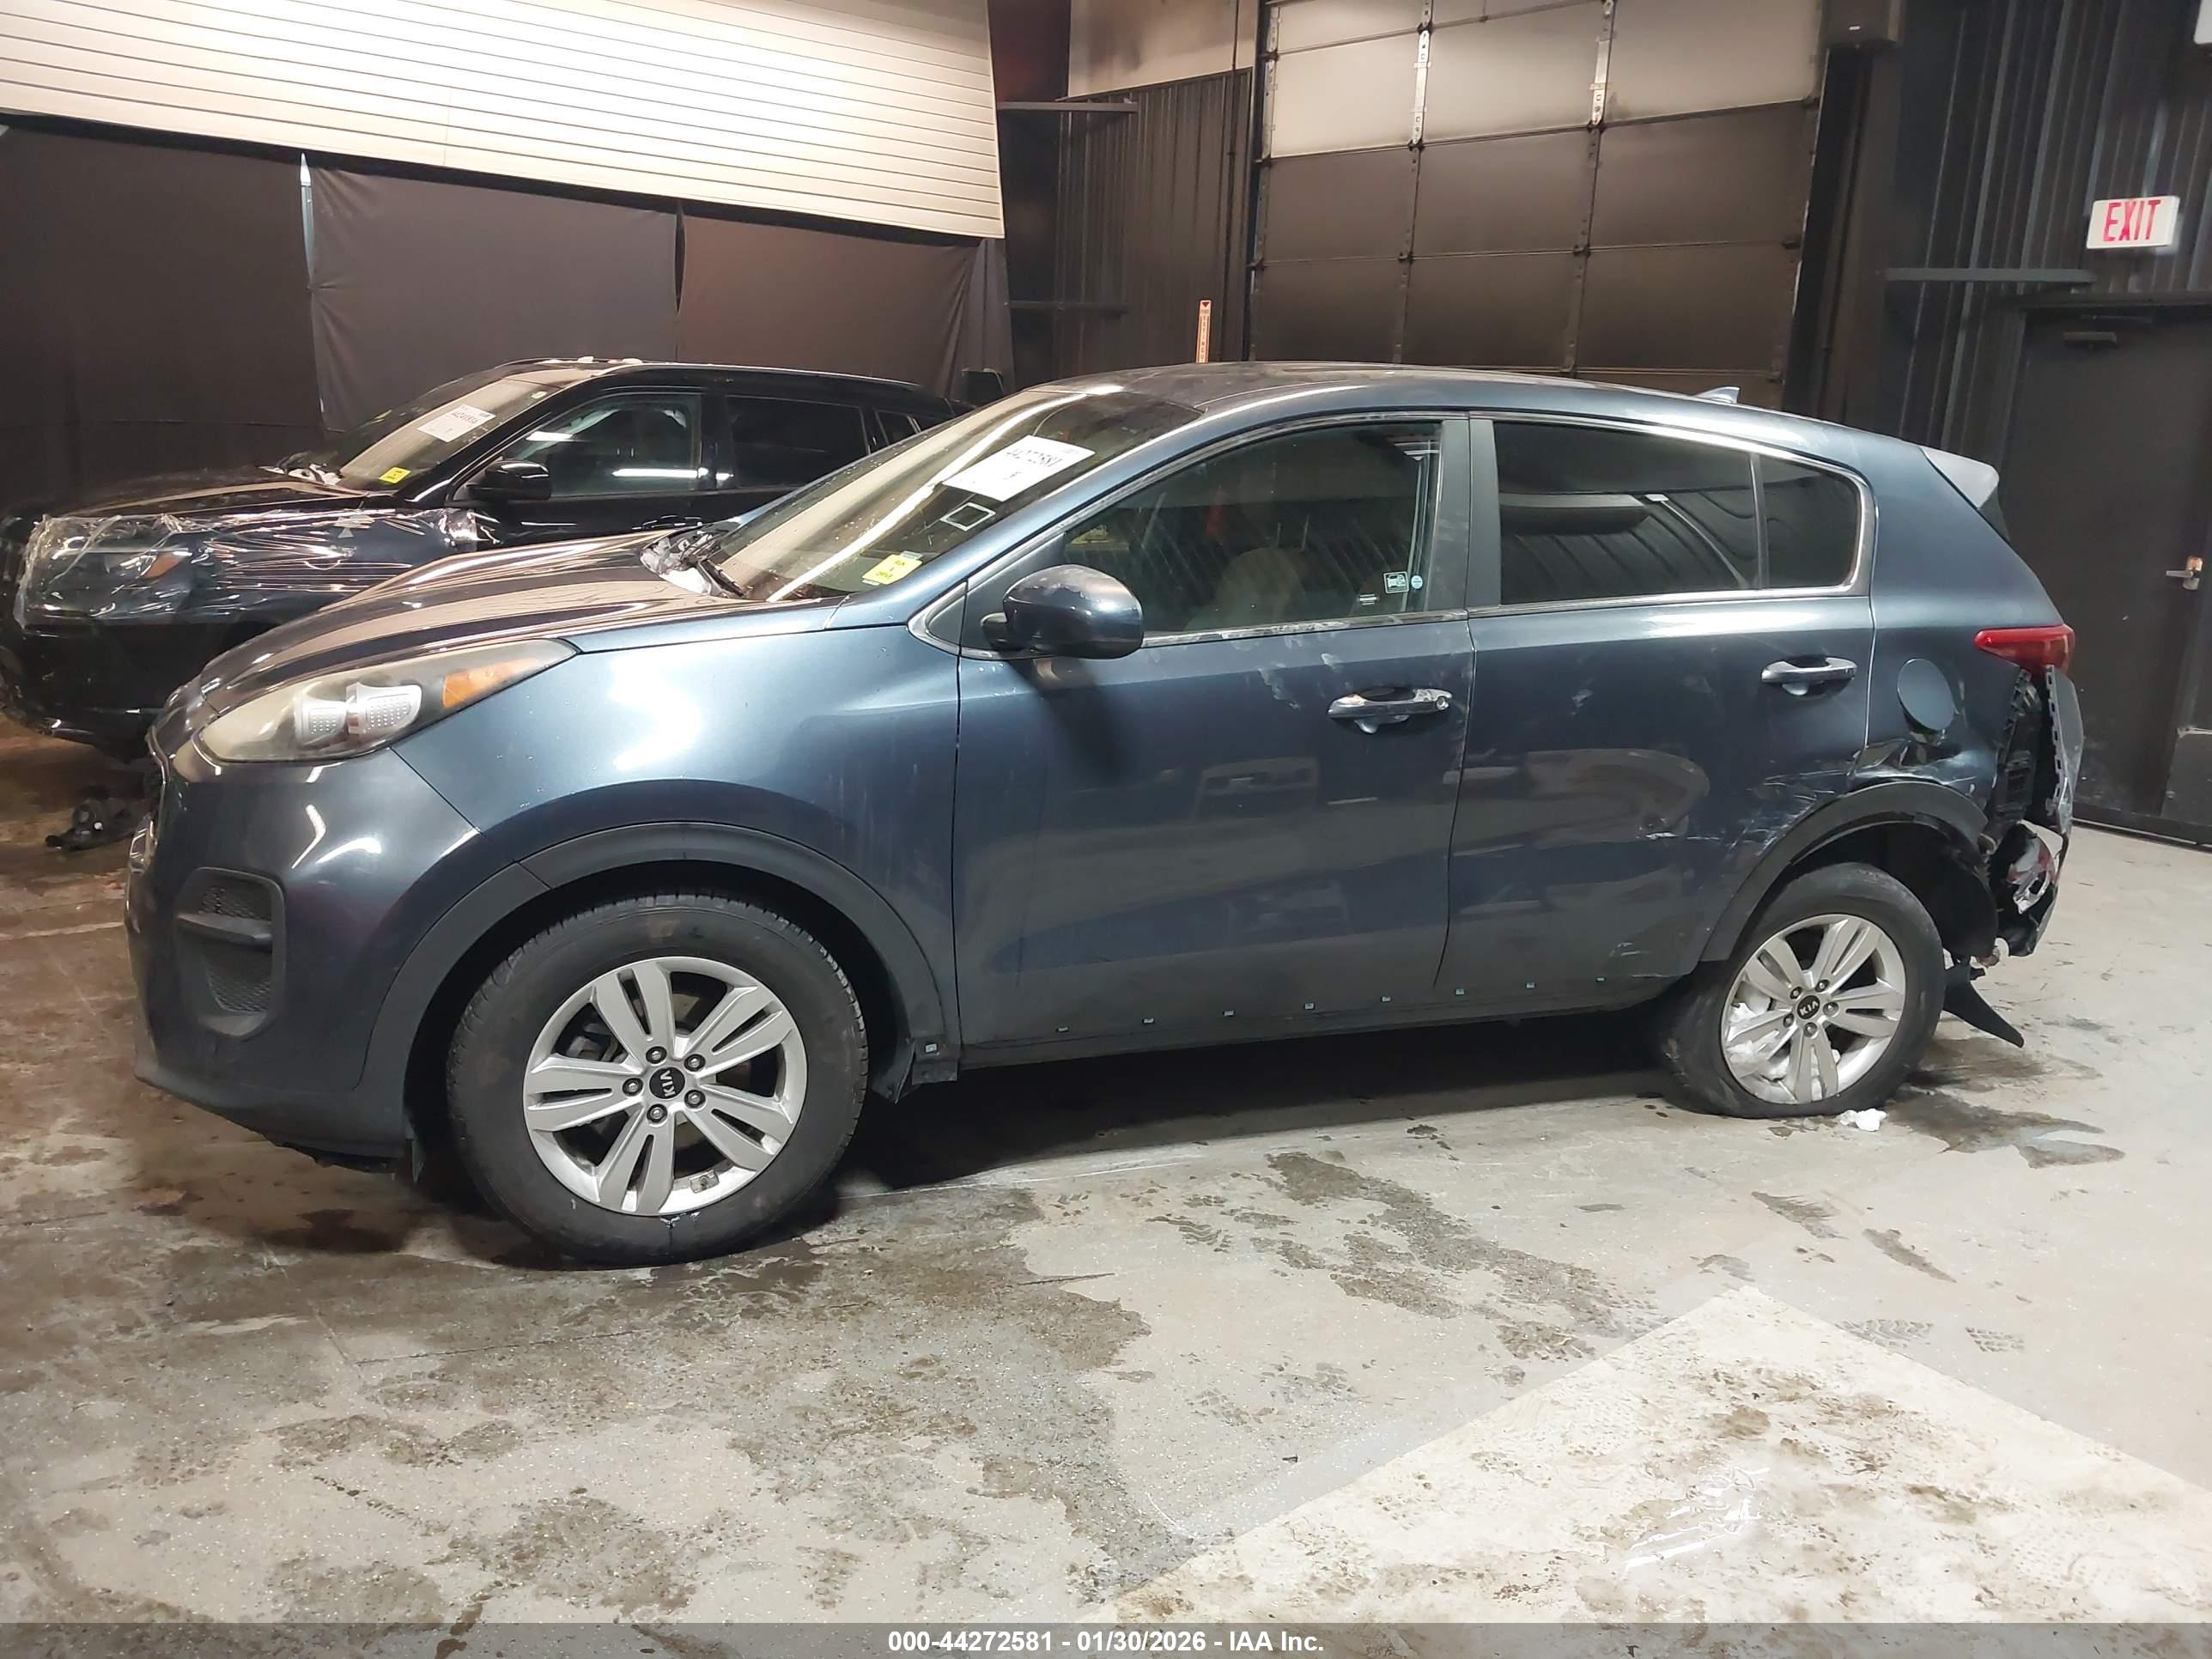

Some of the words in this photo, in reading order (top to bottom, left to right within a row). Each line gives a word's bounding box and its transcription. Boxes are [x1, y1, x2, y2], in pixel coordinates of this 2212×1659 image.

[2102, 199, 2162, 242] EXIT
[1799, 1000, 1819, 1016] KIA
[659, 1069, 676, 1097] KIA
